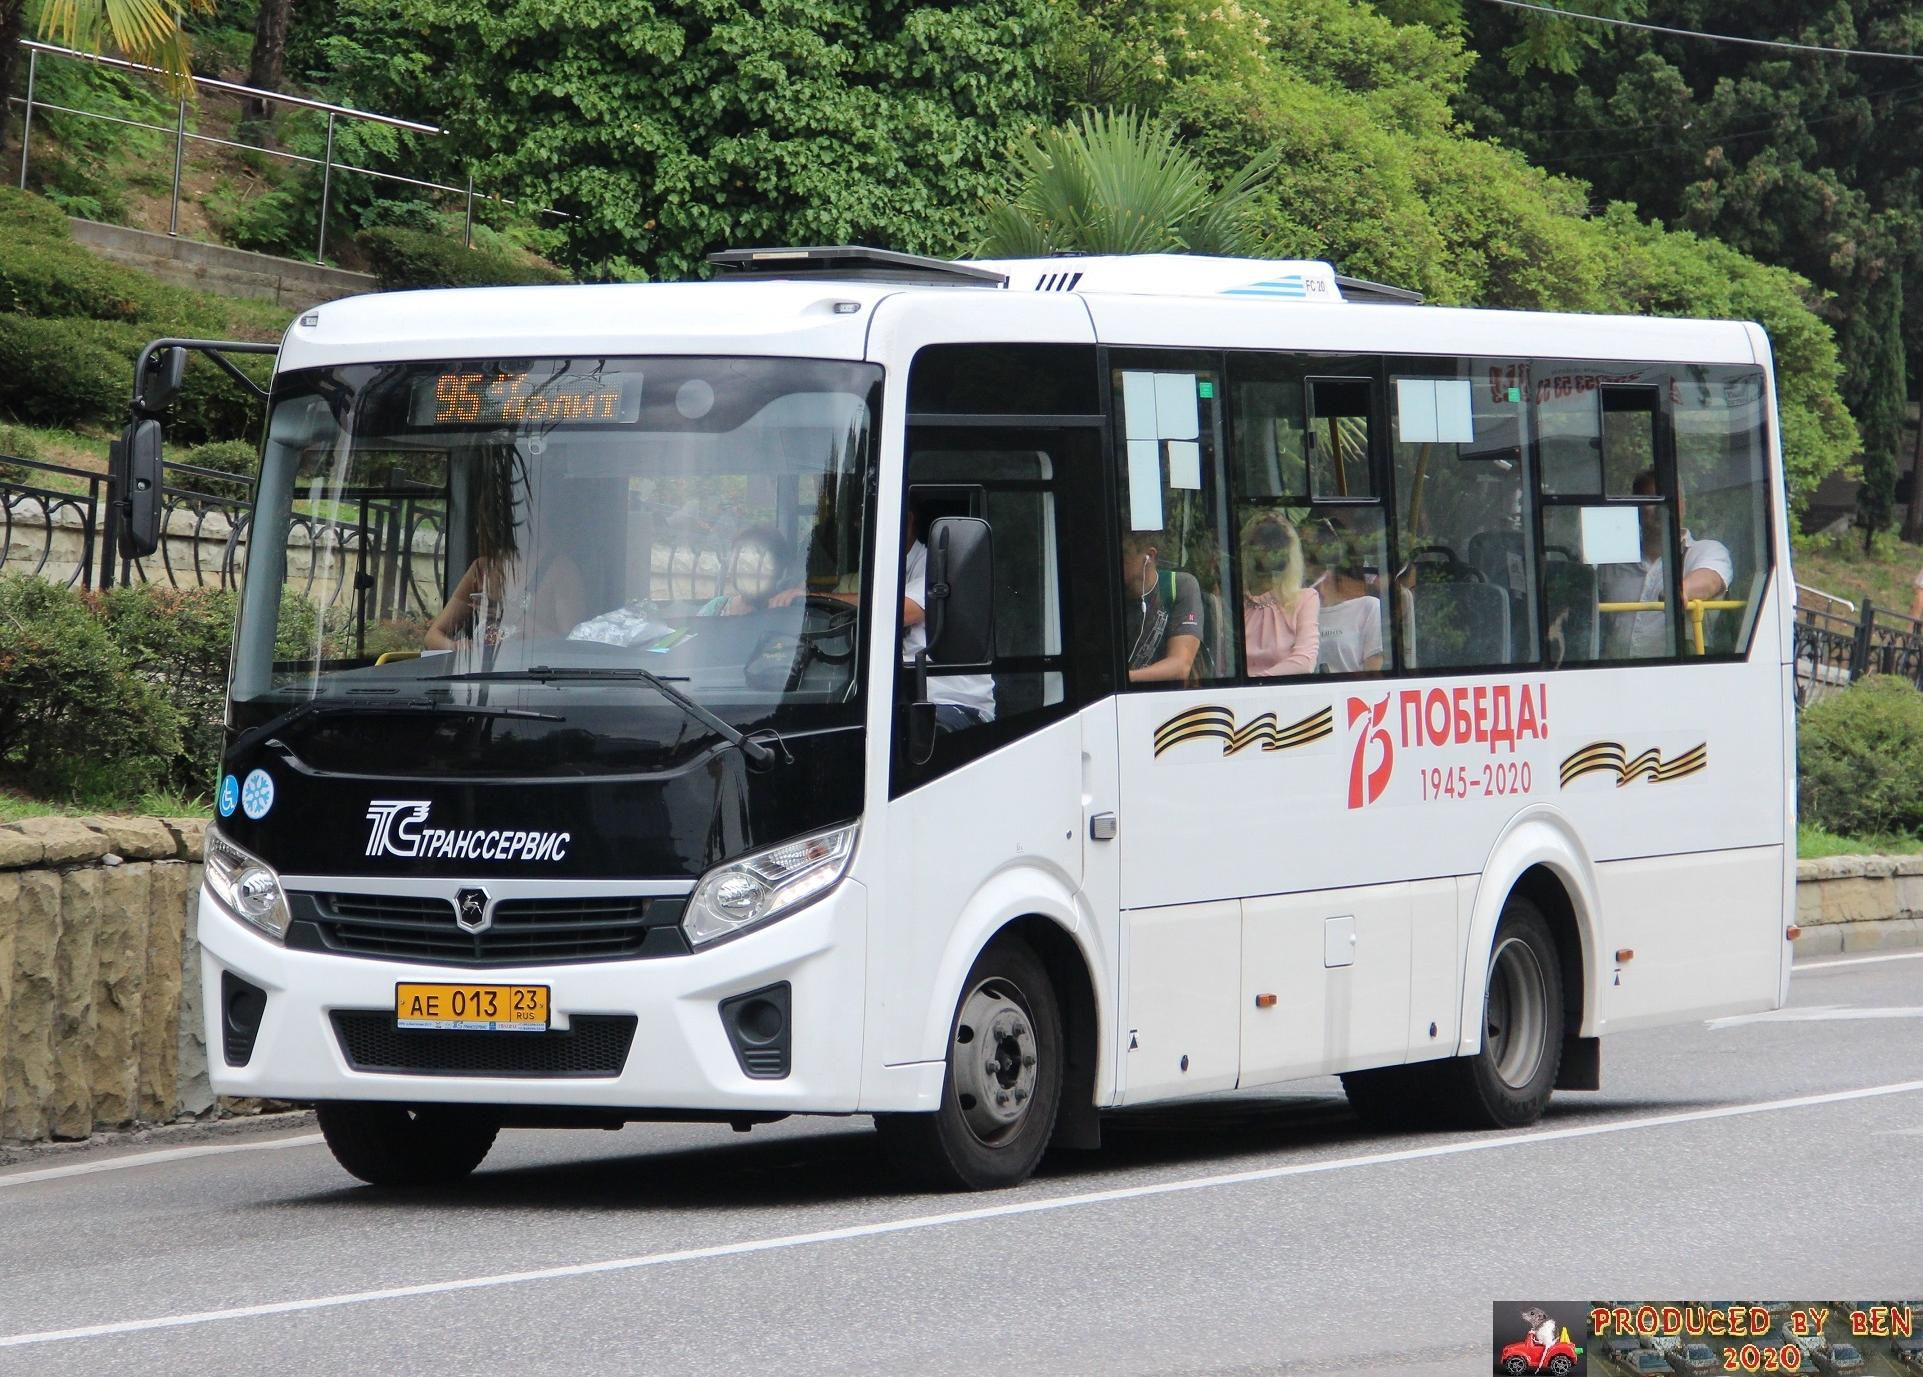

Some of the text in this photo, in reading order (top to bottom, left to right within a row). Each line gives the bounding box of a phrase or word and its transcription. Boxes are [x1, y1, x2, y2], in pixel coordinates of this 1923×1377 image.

[436, 373, 483, 421] 95
[1399, 683, 1549, 754] ПОБЕДА!
[1346, 691, 1394, 809] 75
[418, 829, 571, 861] ТРАНССЕРВИС
[451, 990, 498, 1018] 013
[513, 989, 538, 1011] 23
[516, 1011, 535, 1020] RUS
